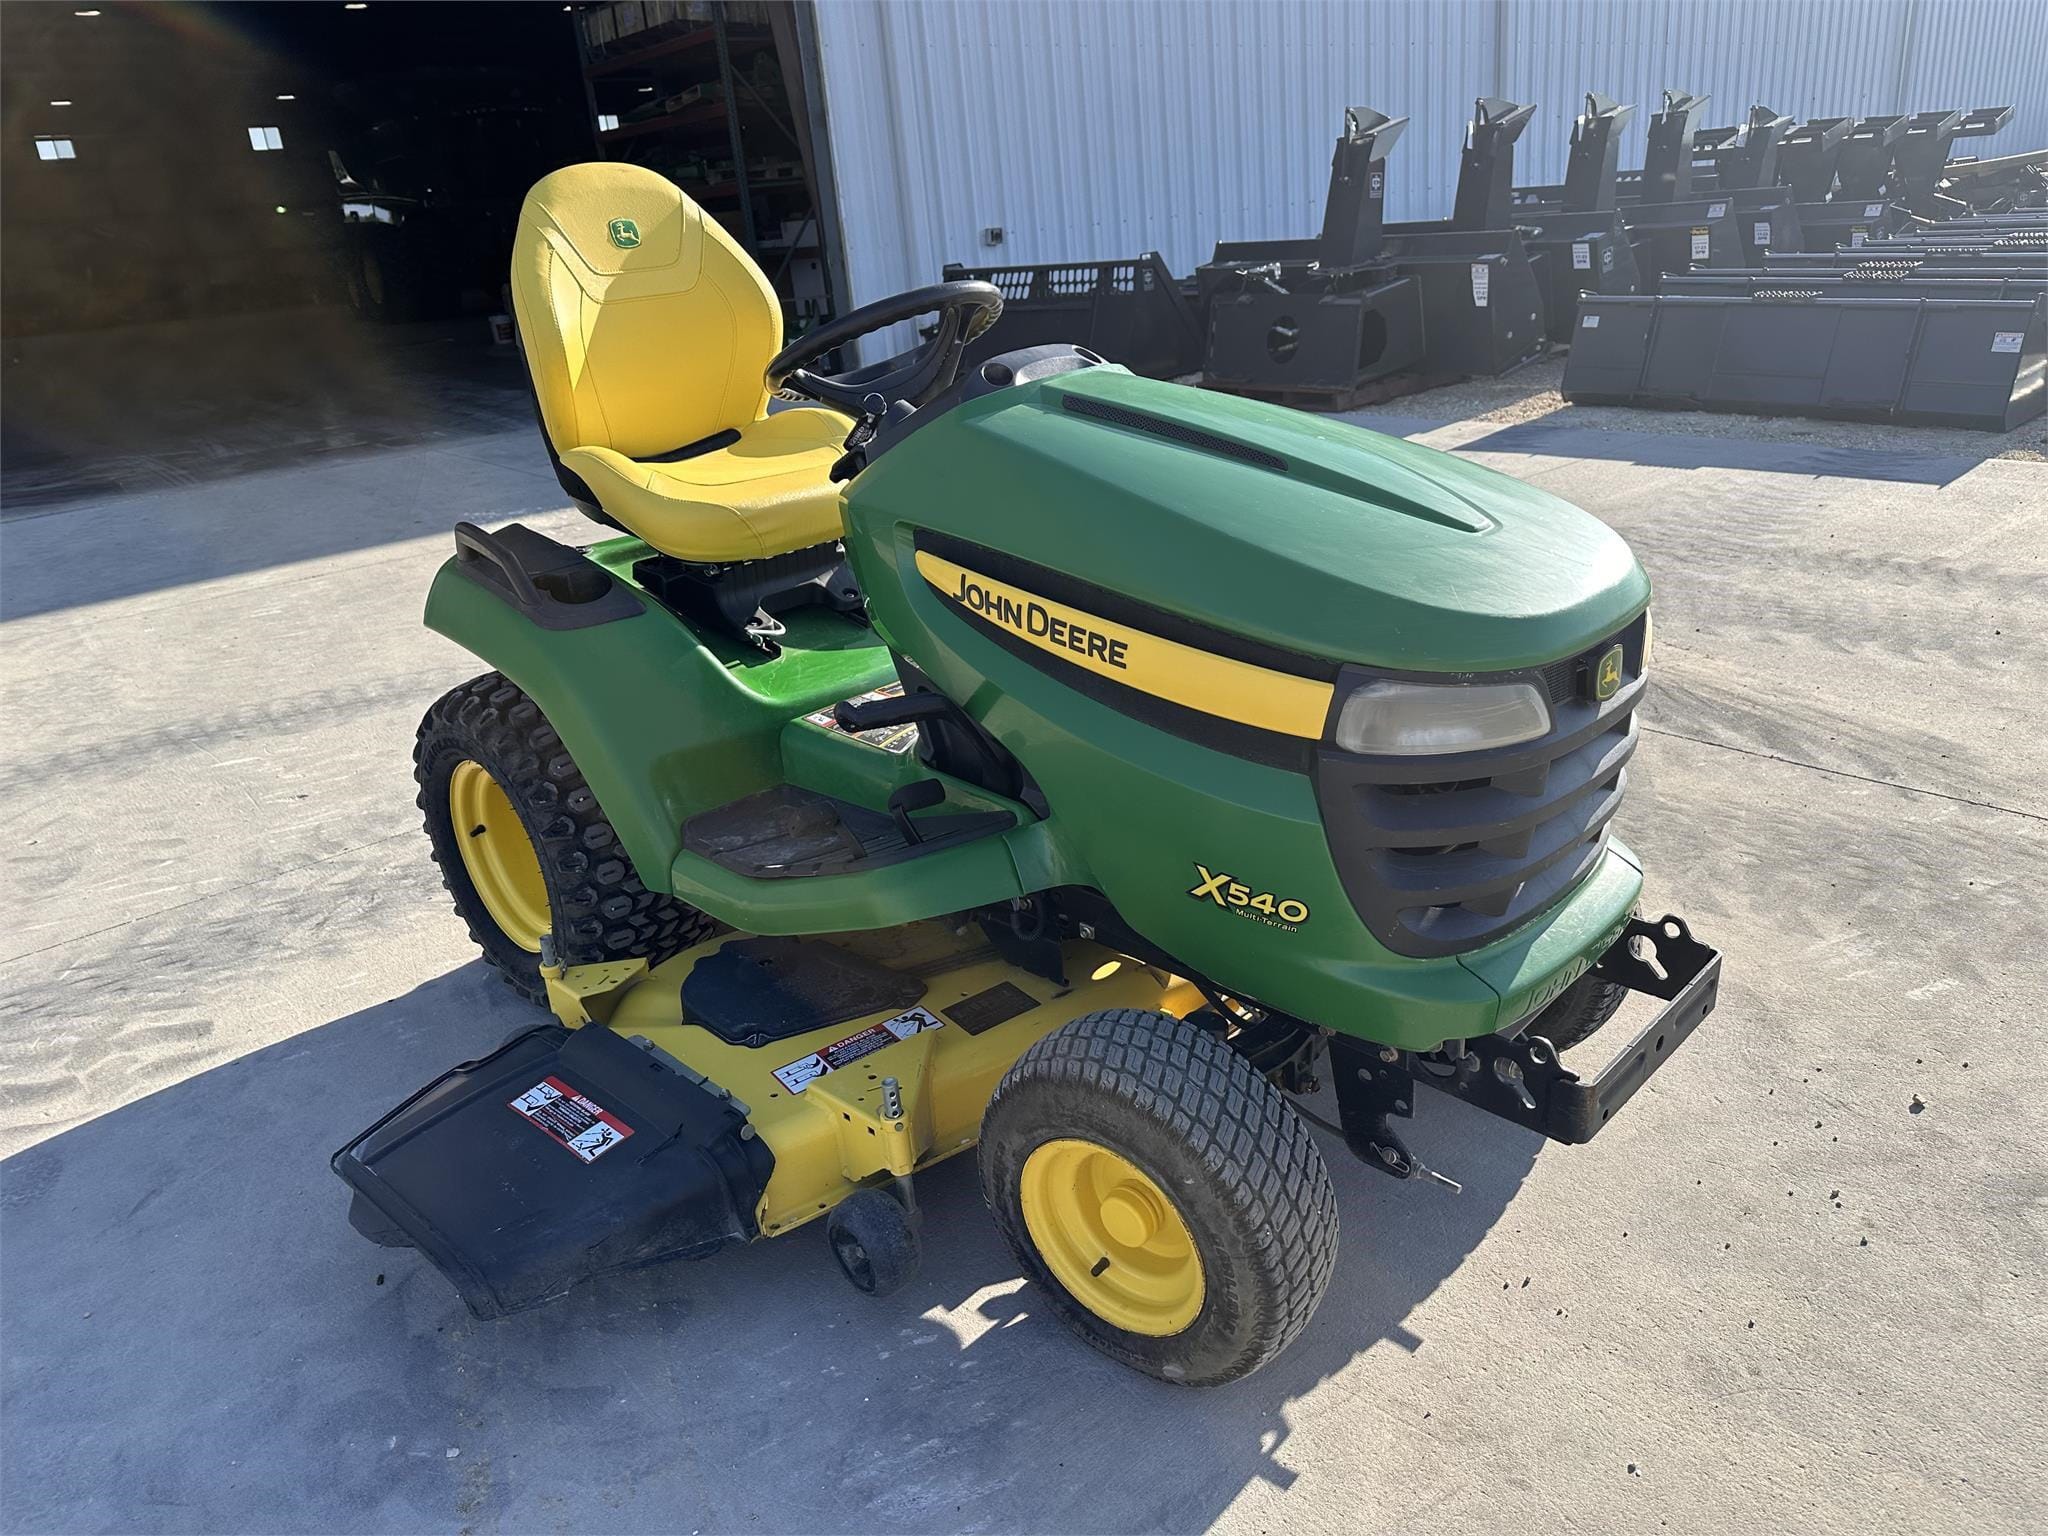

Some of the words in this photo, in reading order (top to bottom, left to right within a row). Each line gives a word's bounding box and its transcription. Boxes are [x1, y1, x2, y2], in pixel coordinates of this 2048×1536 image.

[952, 573, 1023, 629] JOHN
[1026, 601, 1128, 670] DEERE
[1189, 863, 1309, 923] X540
[1235, 908, 1298, 933] Multi-Terrain
[837, 1028, 876, 1048] DANGER
[577, 1096, 604, 1116] DANGER
